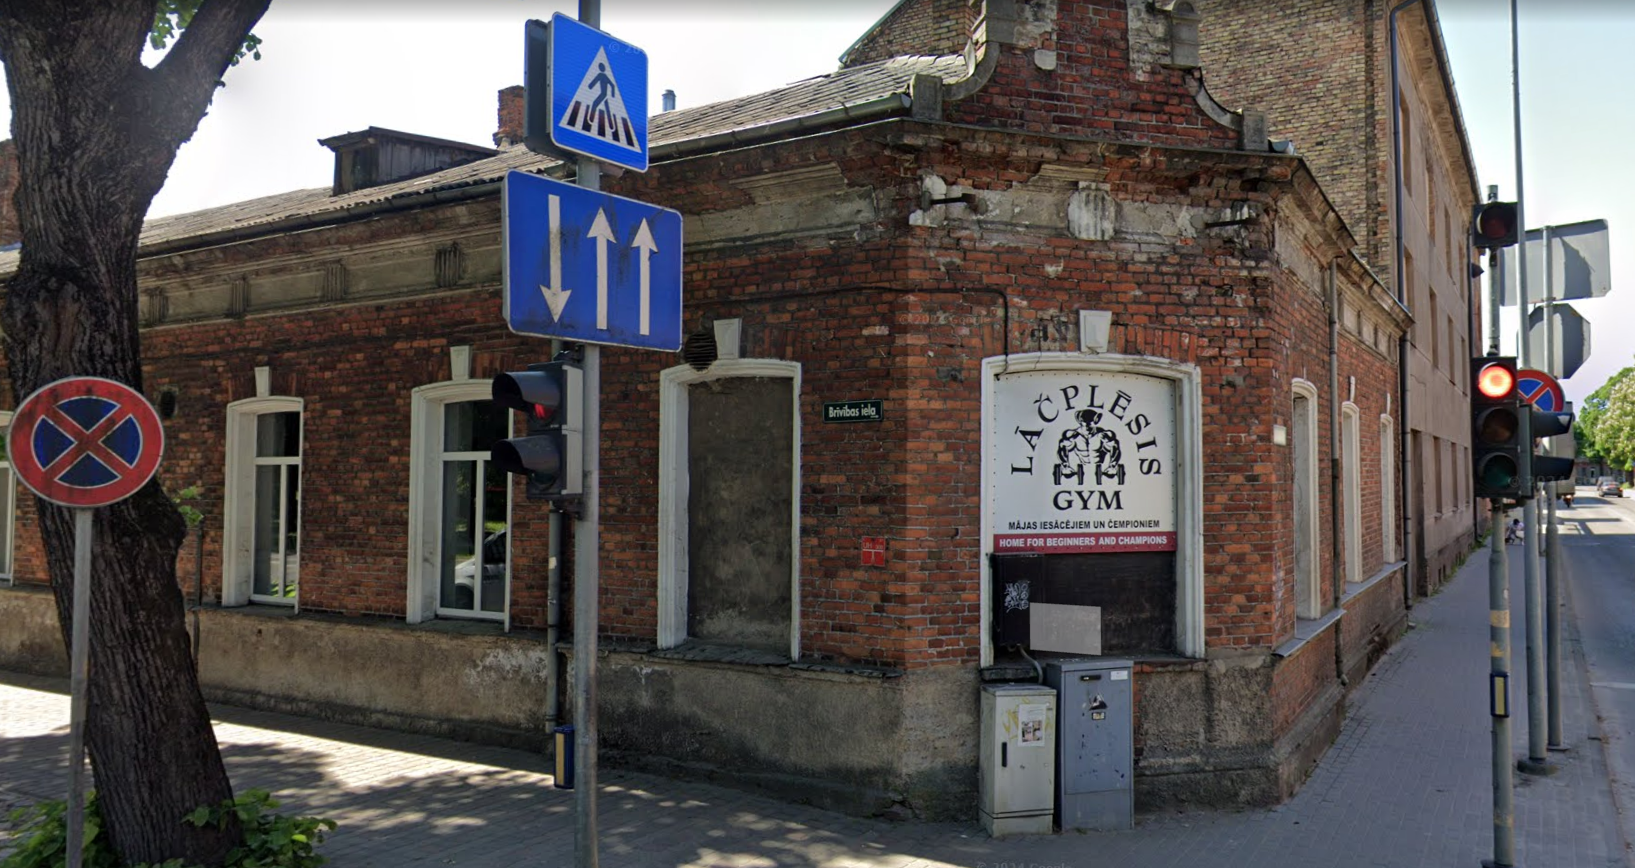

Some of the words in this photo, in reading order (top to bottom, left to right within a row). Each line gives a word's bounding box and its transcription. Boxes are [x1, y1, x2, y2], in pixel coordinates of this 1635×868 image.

[828, 404, 860, 418] Brīvības
[861, 403, 876, 416] iela
[1010, 384, 1162, 476] LĀČPLĒSIS
[1052, 489, 1124, 511] GYM
[1008, 519, 1038, 530] MĀJAS
[1040, 519, 1091, 530] IESĀCĒJIEM
[1093, 520, 1105, 529] UN
[1107, 518, 1160, 529] ČEMPIONIEM
[1000, 538, 1025, 548] HOME
[1027, 538, 1044, 547] FOR
[1046, 537, 1096, 547] BEGINNERS
[1098, 536, 1117, 546] AND
[1118, 535, 1167, 545] CHAMPIONS
